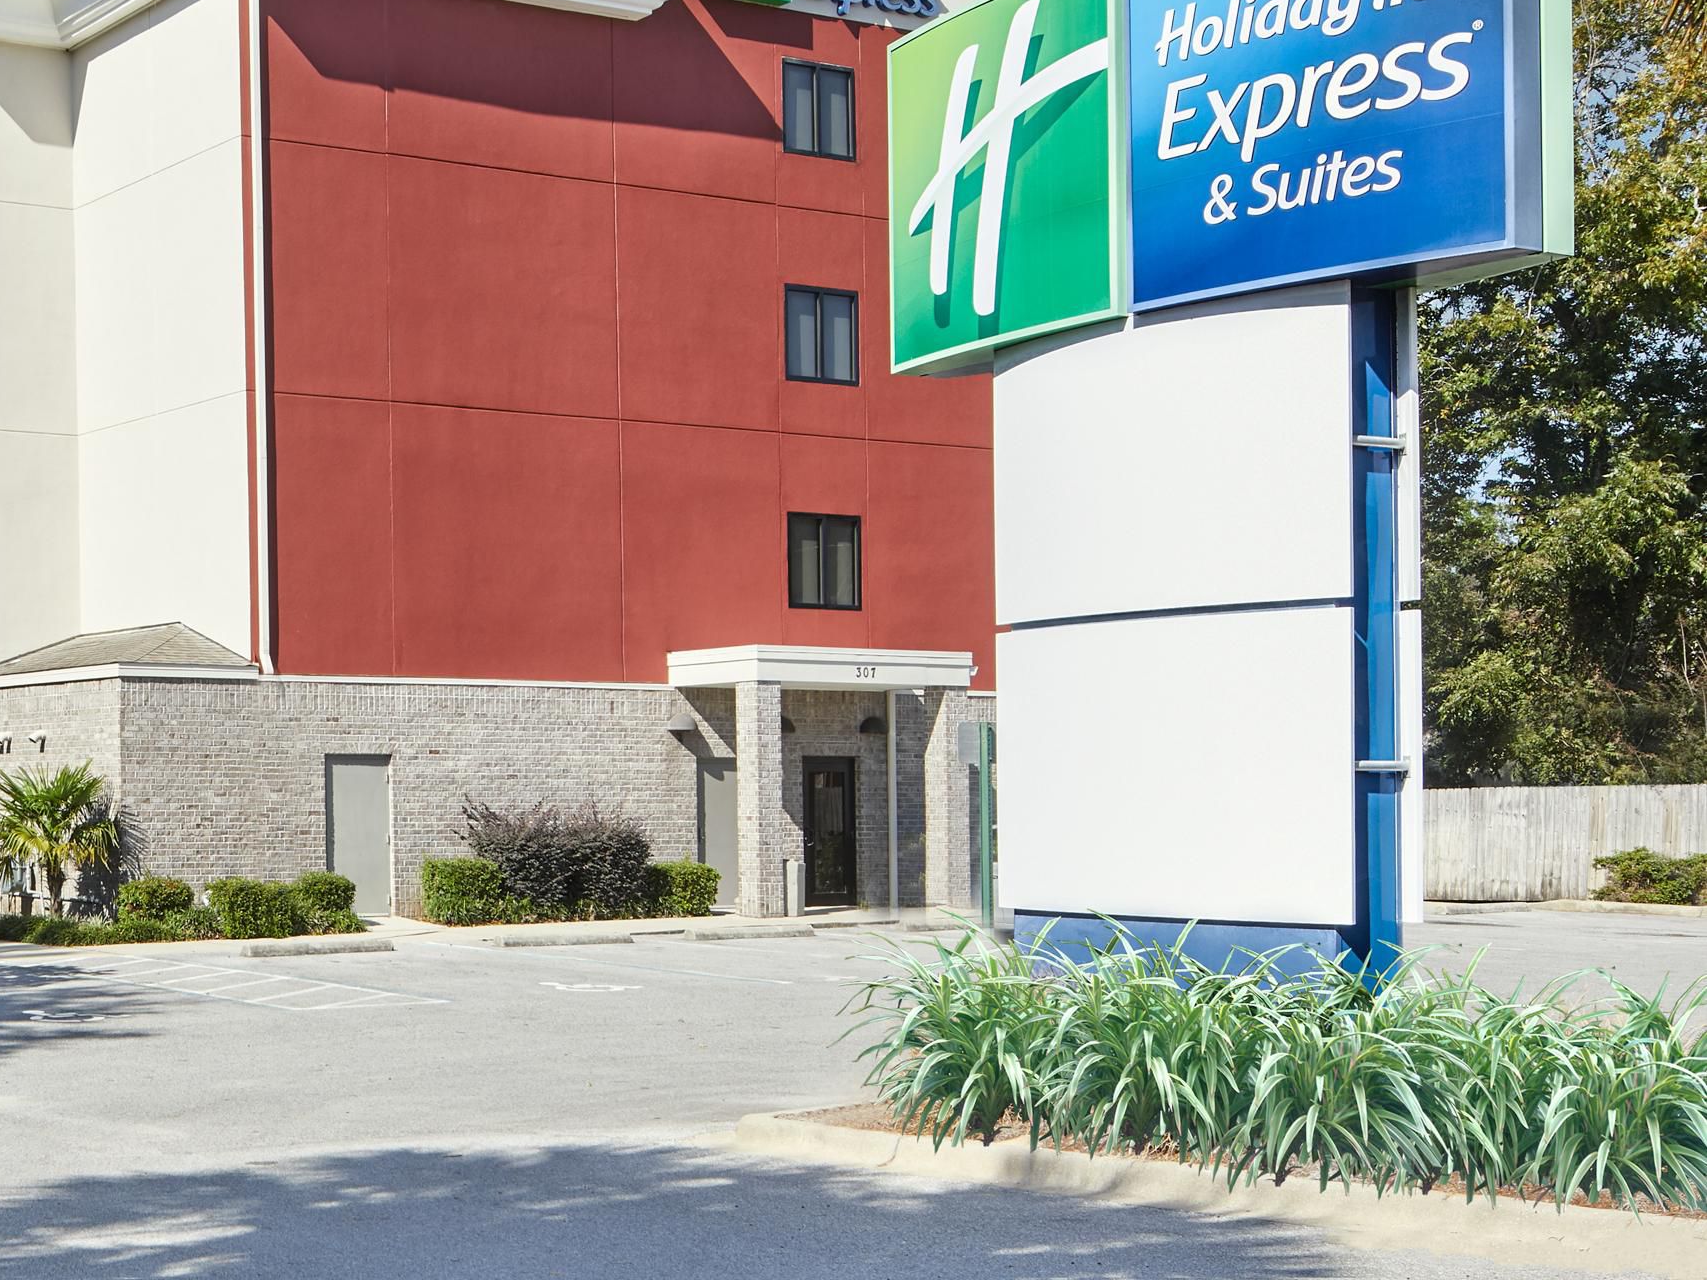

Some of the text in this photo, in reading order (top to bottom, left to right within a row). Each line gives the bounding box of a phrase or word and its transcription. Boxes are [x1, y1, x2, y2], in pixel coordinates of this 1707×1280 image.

[1203, 150, 1403, 224] & Suites
[856, 667, 876, 678] 307
